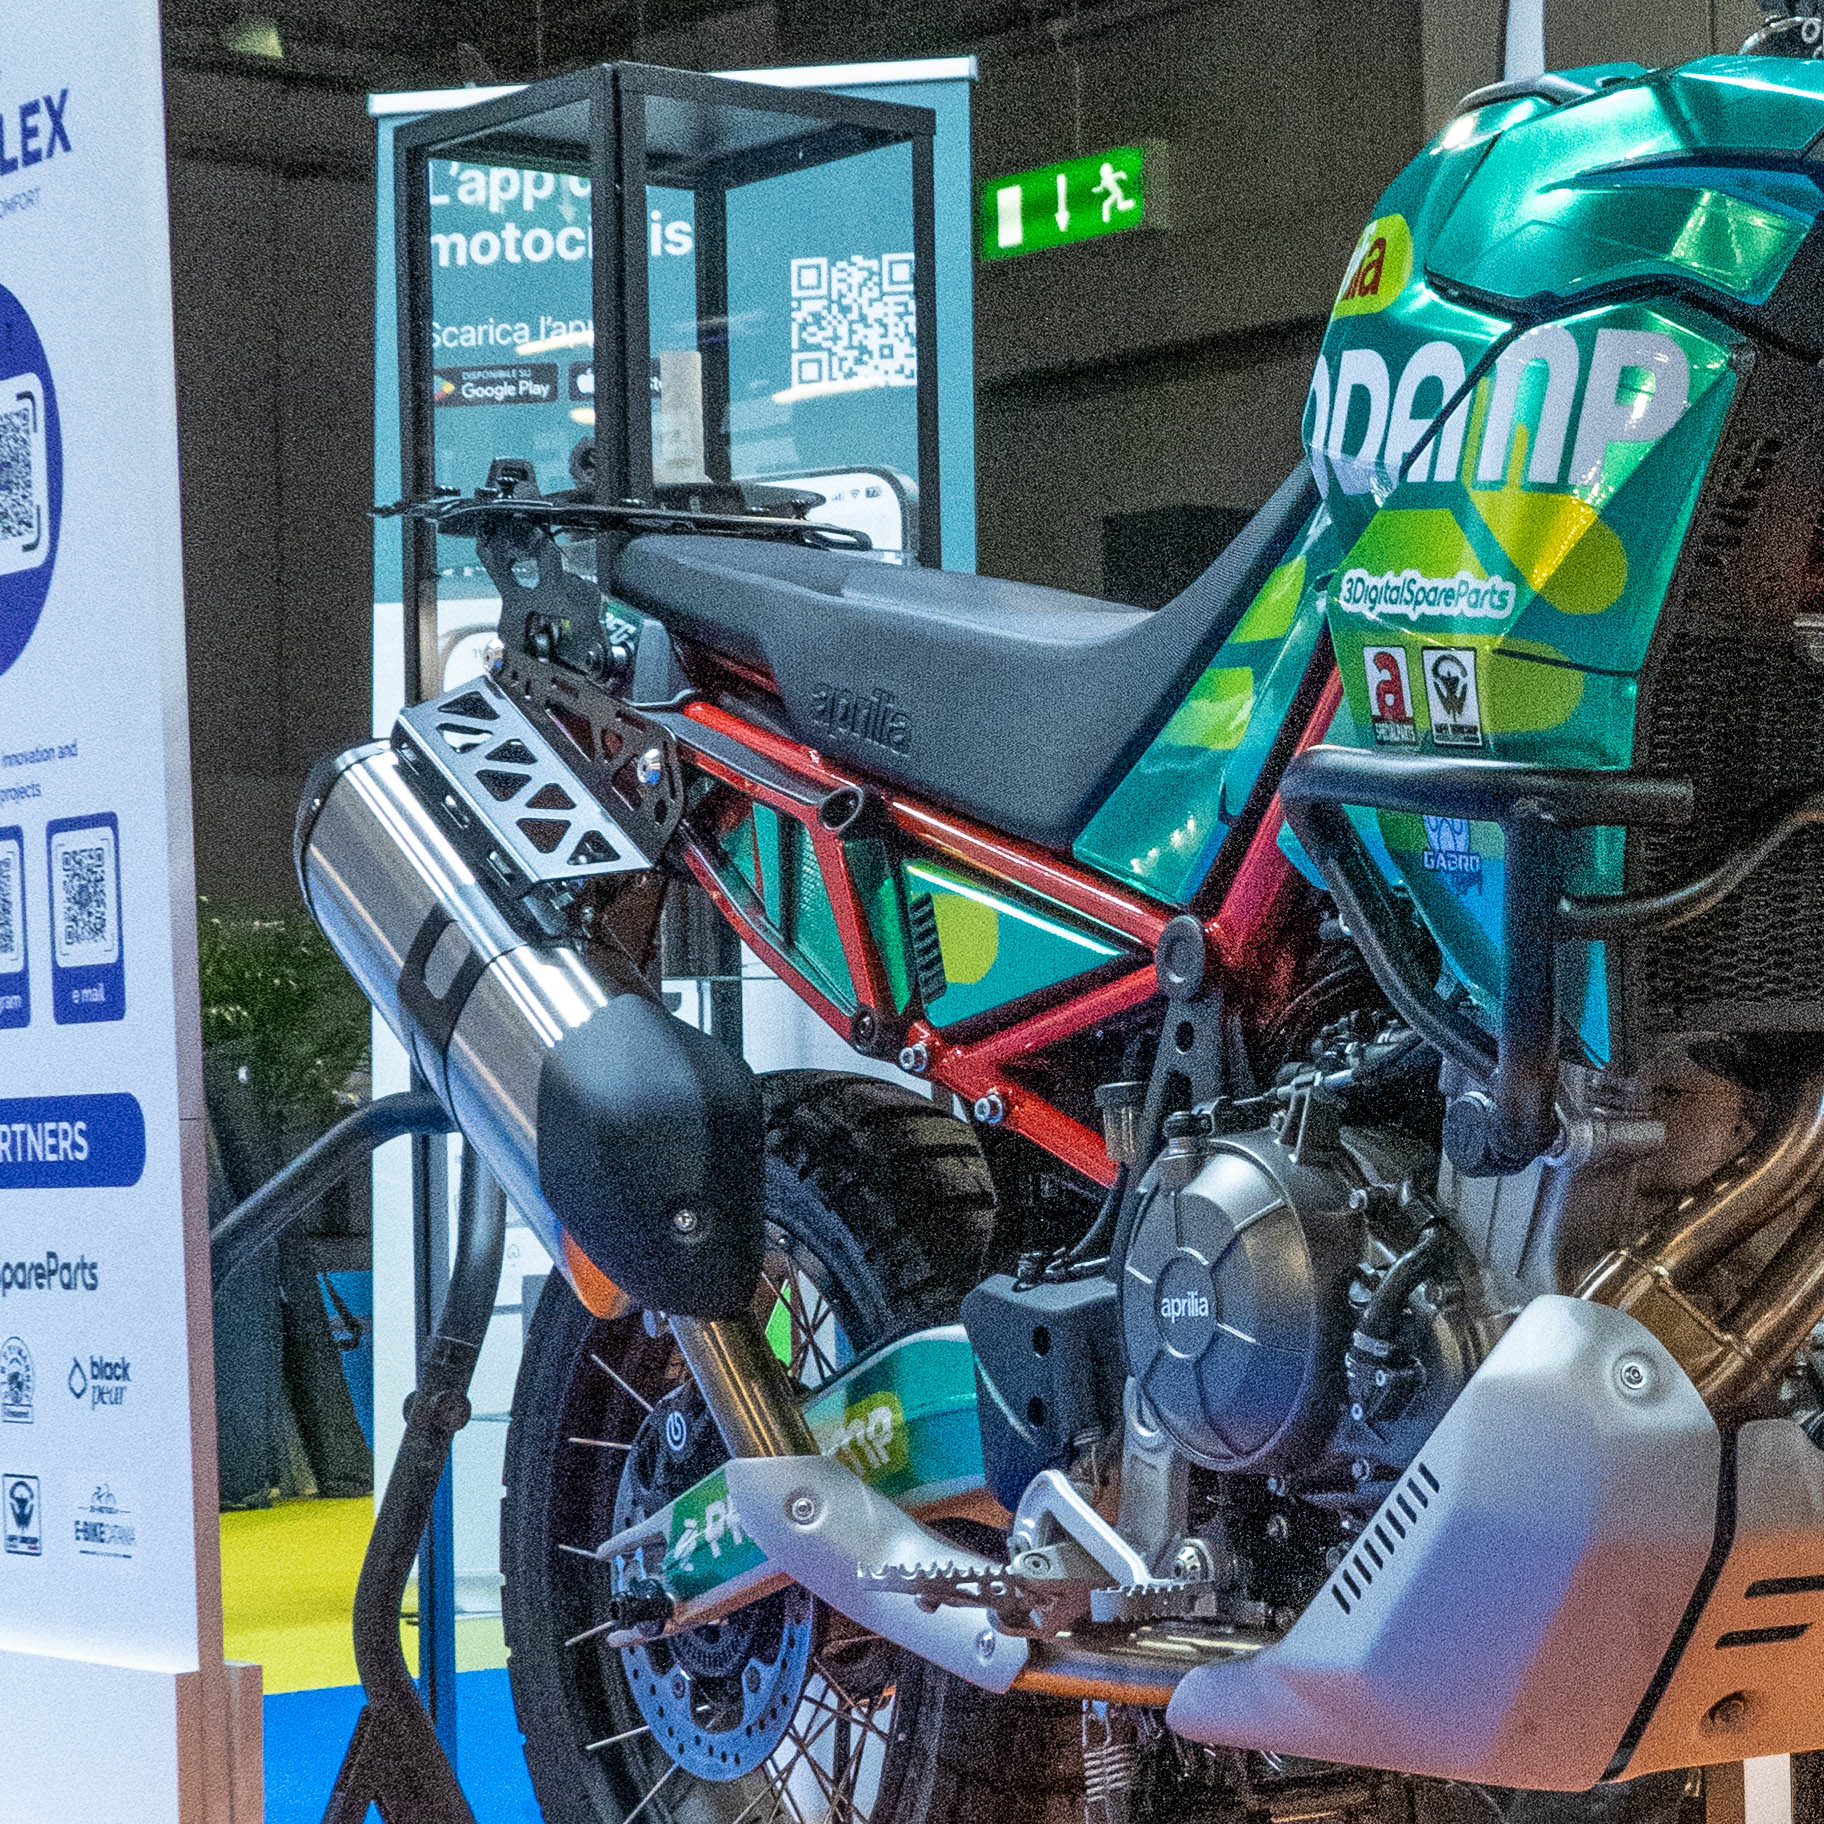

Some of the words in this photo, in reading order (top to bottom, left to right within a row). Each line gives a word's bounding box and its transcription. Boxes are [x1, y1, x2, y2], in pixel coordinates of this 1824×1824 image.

[461, 382, 515, 400] Google
[518, 379, 550, 399] Play
[1342, 575, 1511, 612] 3DigitalSpareParts
[811, 683, 914, 757] aprilia
[58, 739, 78, 761] and
[1161, 1291, 1209, 1323] aprilia
[90, 1355, 131, 1382] black
